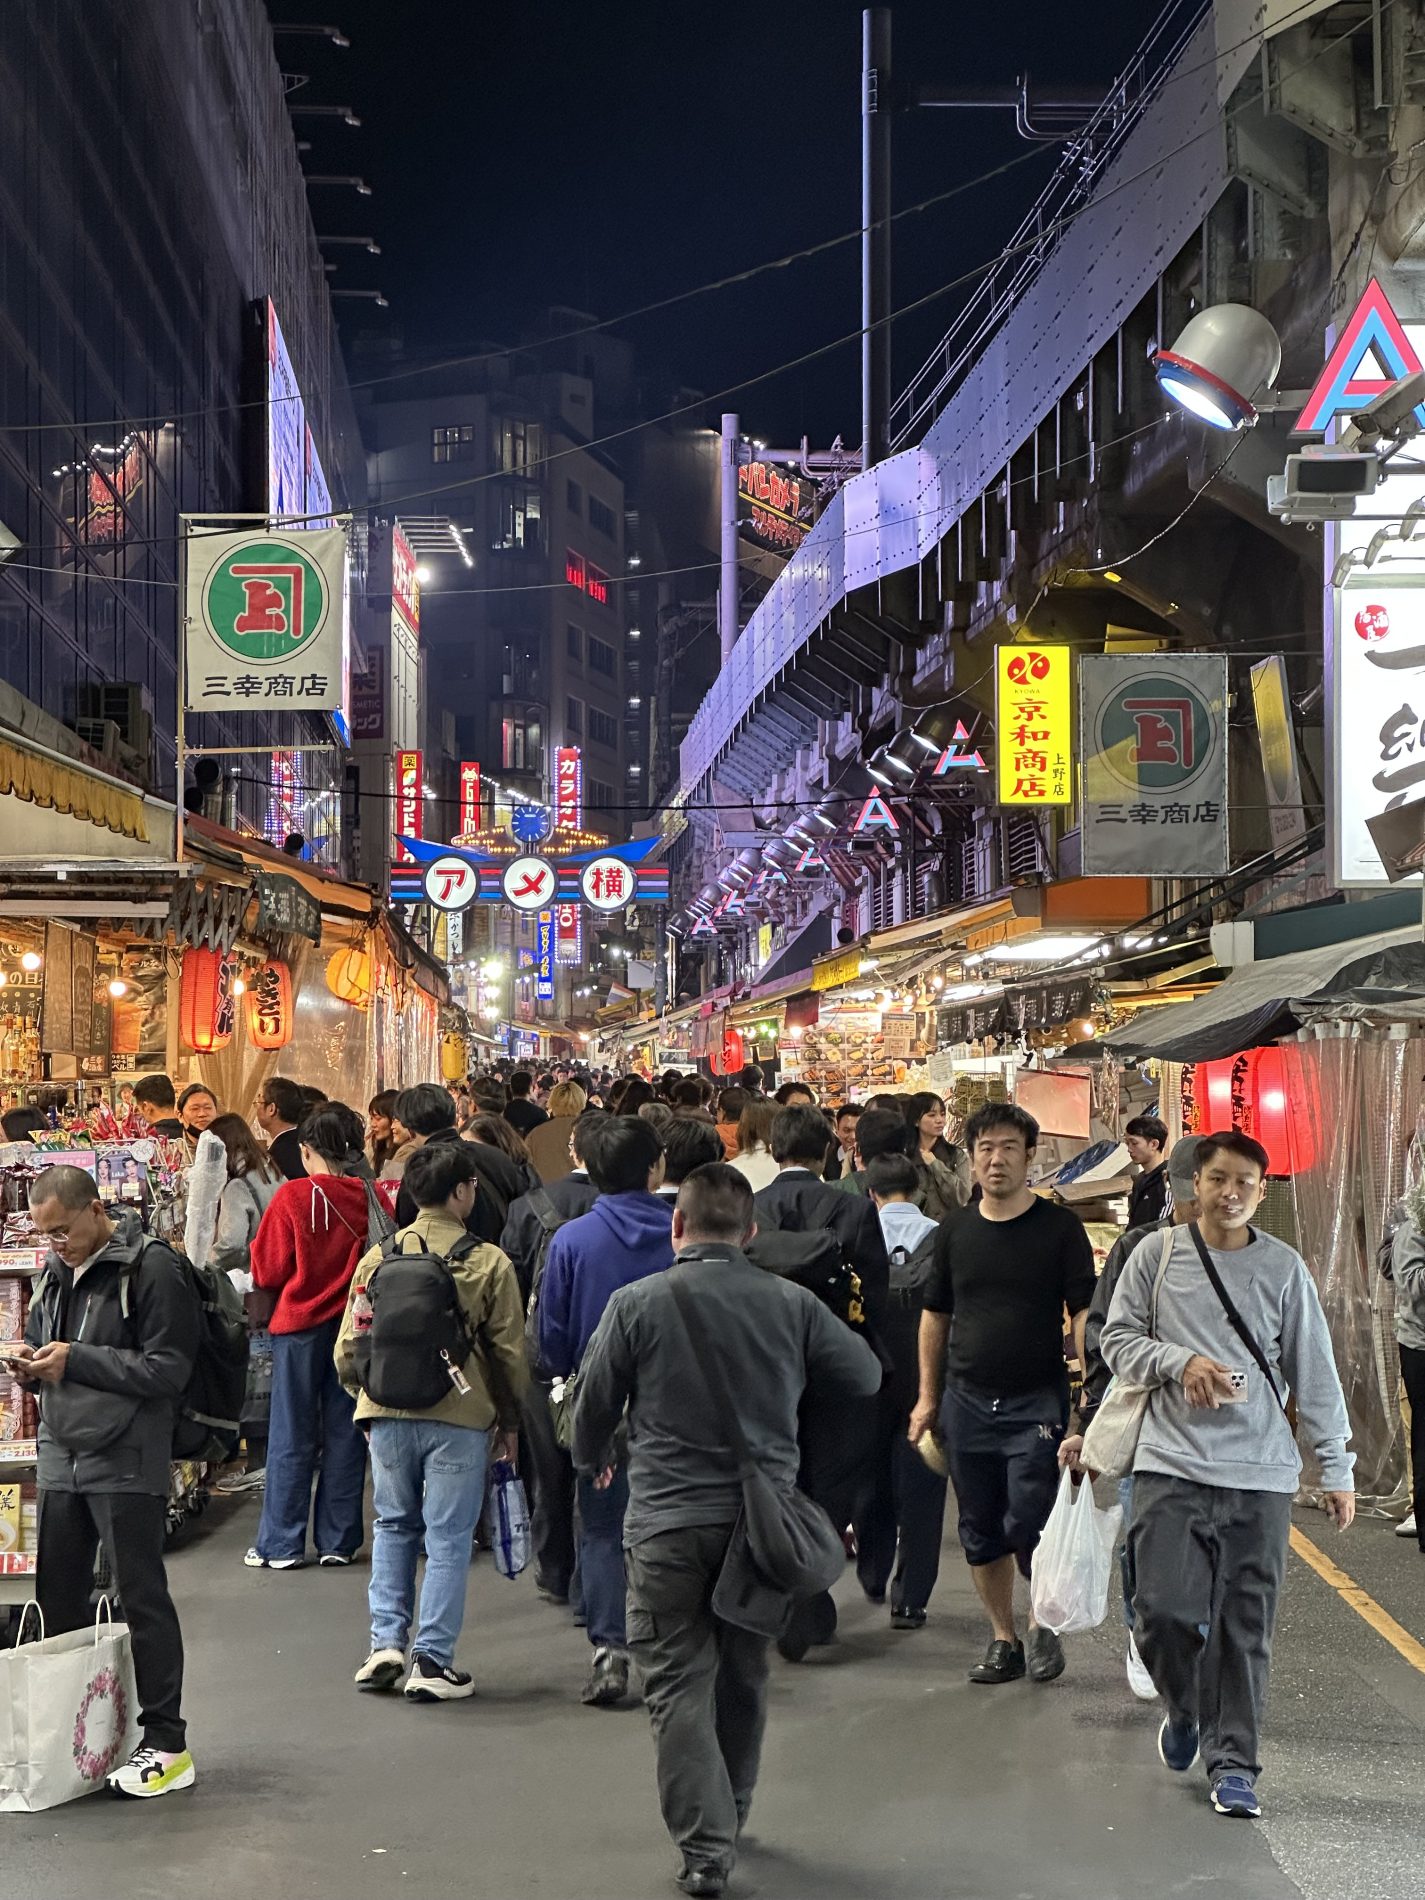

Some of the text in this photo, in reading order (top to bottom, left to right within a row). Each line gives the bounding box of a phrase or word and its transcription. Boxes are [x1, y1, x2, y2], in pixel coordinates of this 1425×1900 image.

[201, 673, 329, 698] 三幸商店
[1008, 697, 1051, 798] 京和商店
[1052, 753, 1066, 796] 上野店
[1095, 801, 1220, 825] 三幸商店
